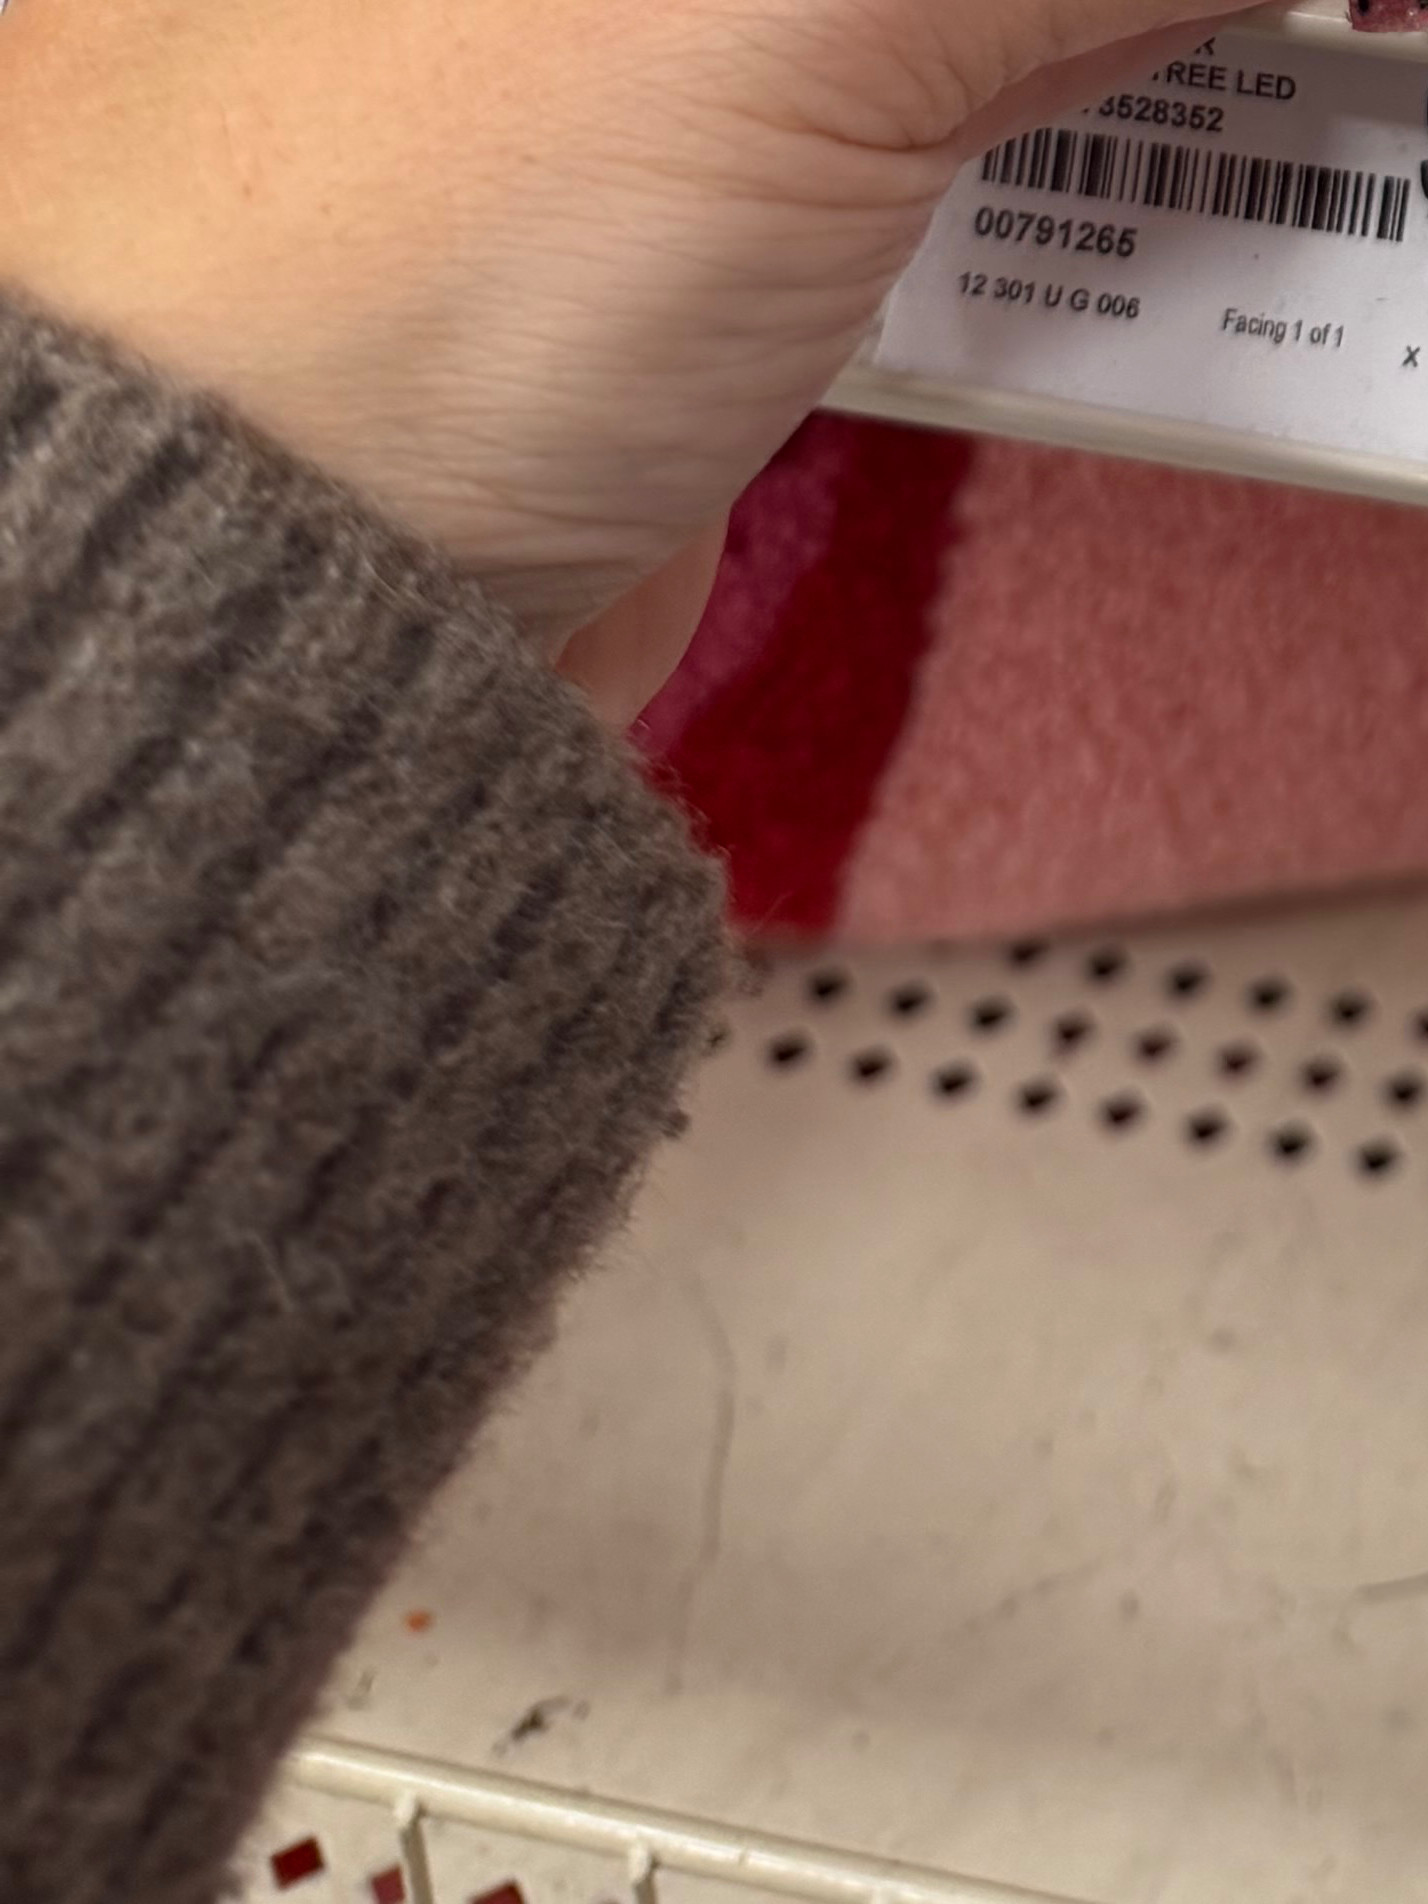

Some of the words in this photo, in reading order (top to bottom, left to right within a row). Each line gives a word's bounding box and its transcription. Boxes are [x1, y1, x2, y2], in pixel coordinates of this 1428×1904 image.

[1153, 60, 1227, 91] REE
[1236, 70, 1297, 100] LED
[1083, 94, 1225, 132] 3528352
[974, 206, 1138, 258] 00791265
[958, 271, 988, 295] 12
[994, 277, 1036, 304] 301
[1044, 284, 1063, 308] U
[1070, 288, 1090, 312] G
[1098, 294, 1141, 320] 006
[1221, 307, 1288, 344] Facing
[1294, 320, 1303, 341] 1
[1310, 323, 1331, 346] of
[1335, 325, 1344, 348] 1
